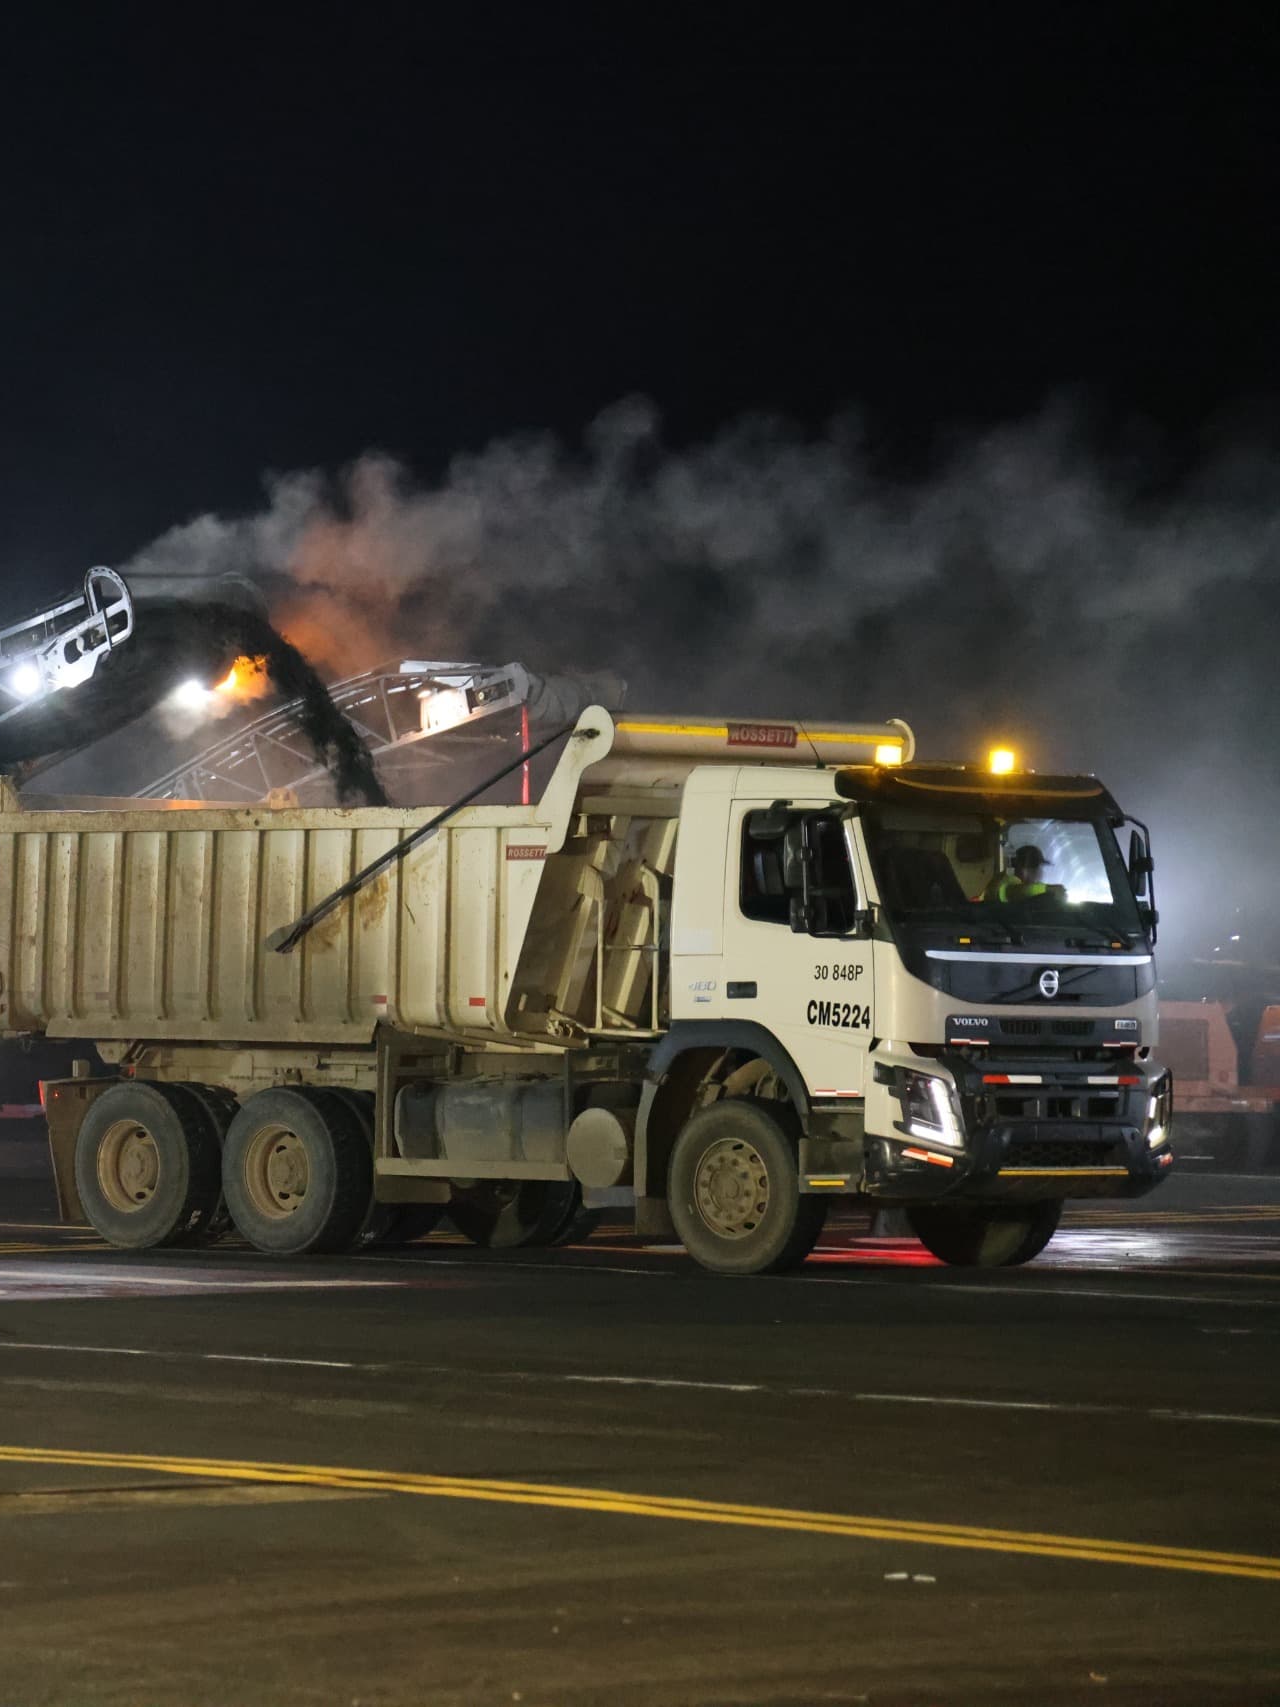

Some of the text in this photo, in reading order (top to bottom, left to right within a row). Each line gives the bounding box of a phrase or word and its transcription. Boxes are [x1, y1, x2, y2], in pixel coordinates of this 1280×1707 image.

[814, 964, 864, 981] 30 848P
[807, 999, 870, 1029] CM5224
[952, 1017, 989, 1026] VOLVO
